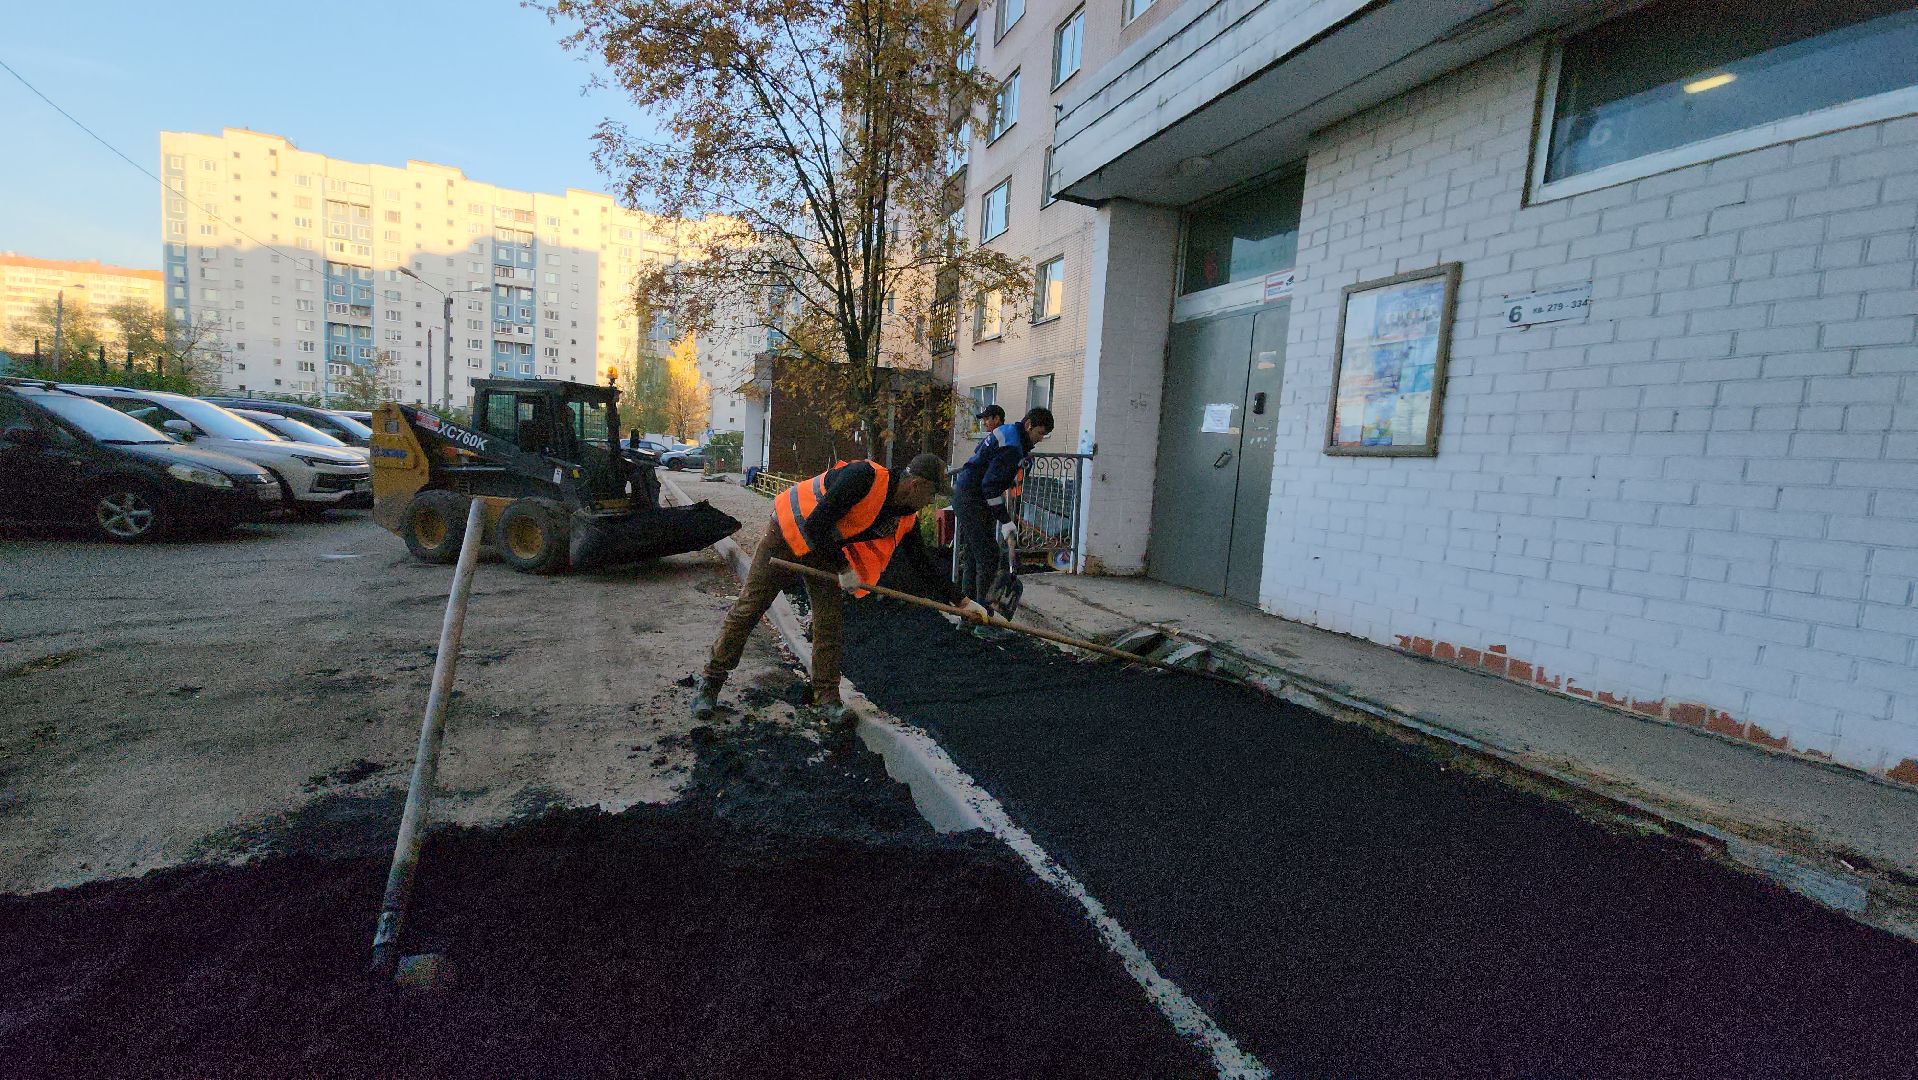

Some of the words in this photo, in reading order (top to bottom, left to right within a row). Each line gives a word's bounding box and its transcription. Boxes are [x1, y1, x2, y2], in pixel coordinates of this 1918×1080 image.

[1509, 305, 1523, 323] 6
[1546, 302, 1564, 313] 279
[437, 421, 488, 451] XC760K
